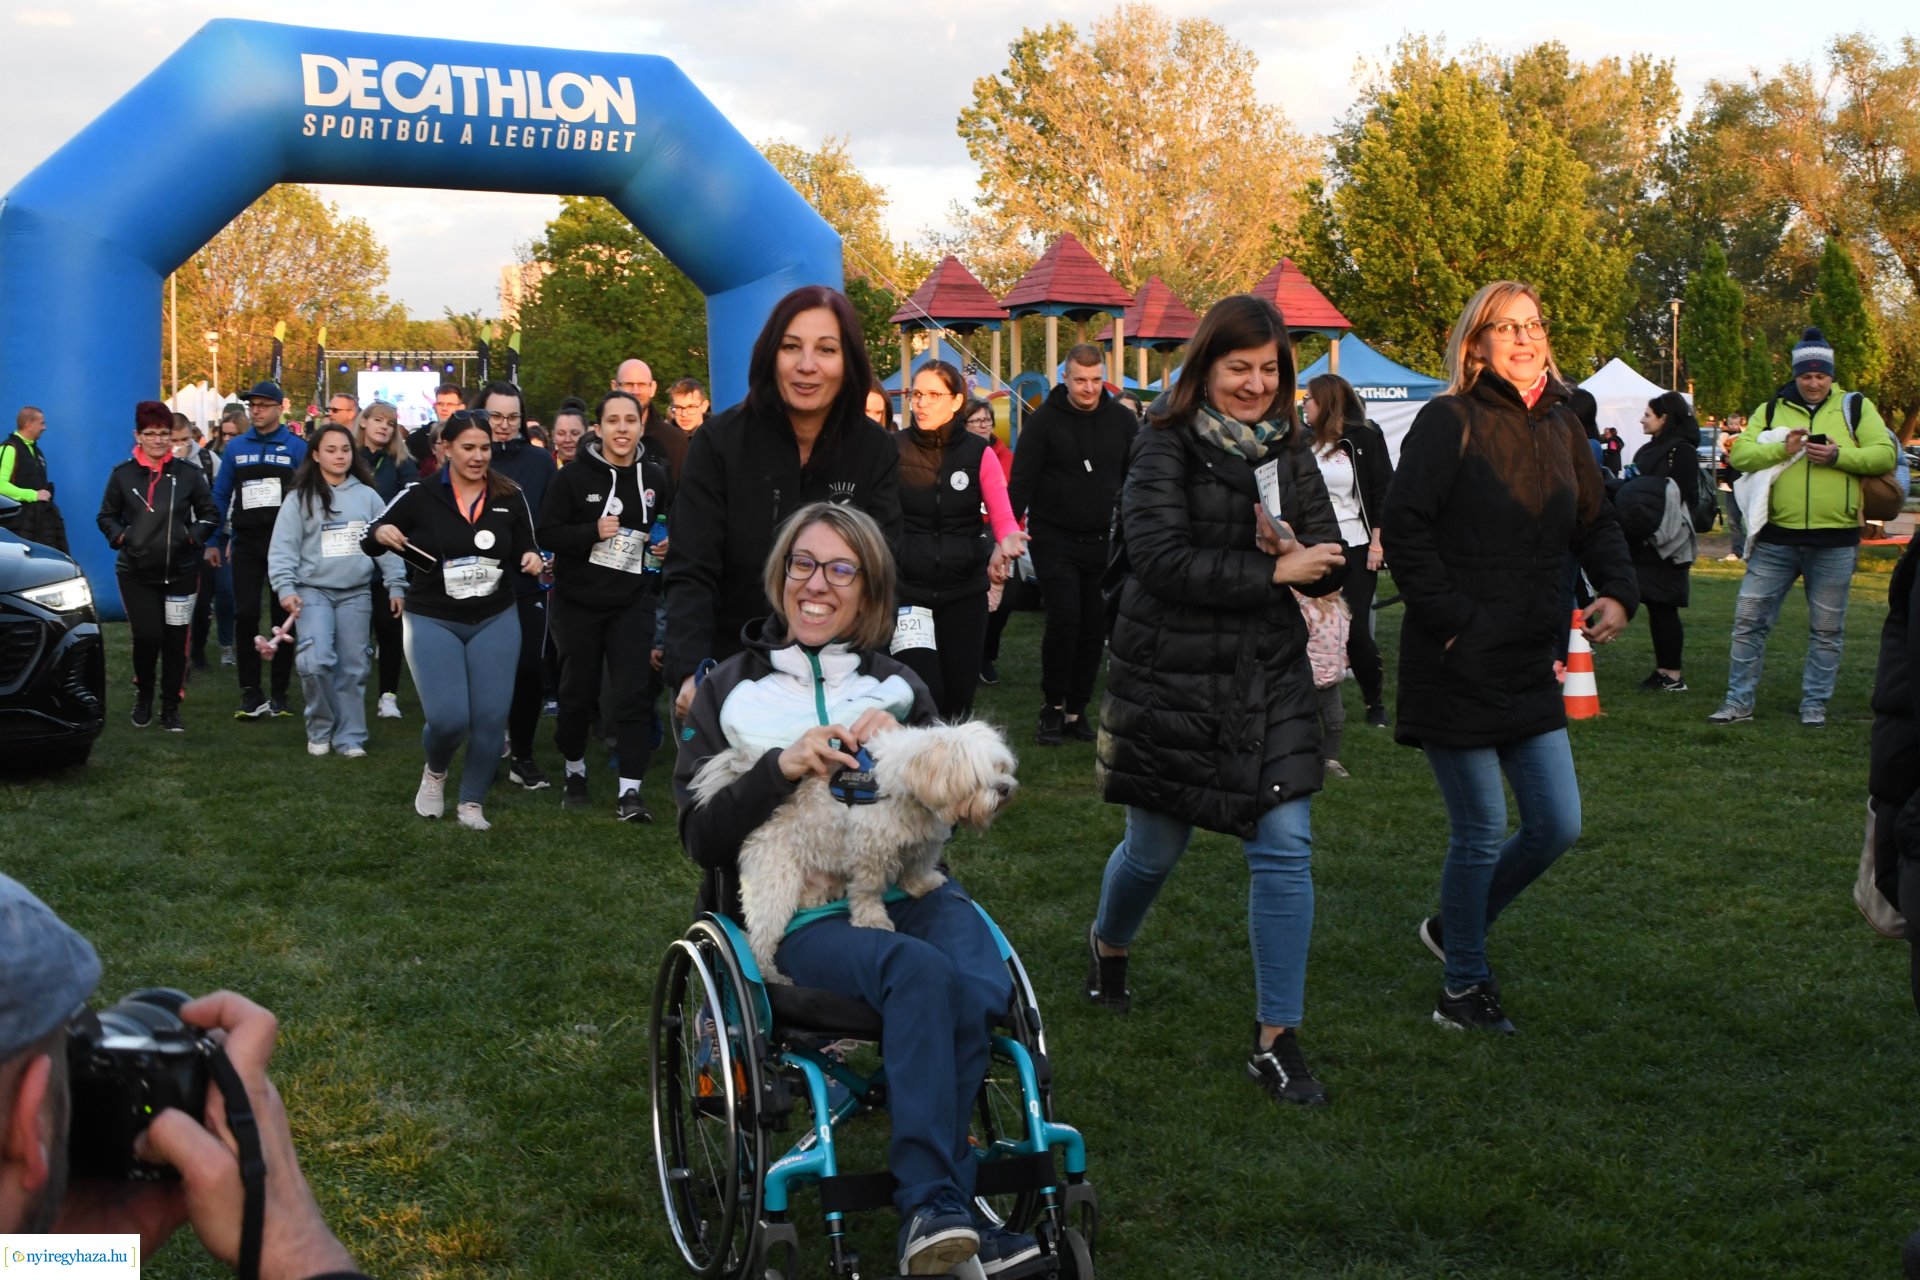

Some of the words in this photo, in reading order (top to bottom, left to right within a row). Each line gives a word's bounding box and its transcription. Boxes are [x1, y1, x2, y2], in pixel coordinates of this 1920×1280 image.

[300, 53, 637, 125] DECATHLON
[302, 113, 444, 145] SPORTBÓL
[460, 126, 474, 145] A
[489, 122, 637, 153] LEGTÖBBET
[250, 486, 271, 497] 1795
[609, 538, 637, 555] 1522
[462, 567, 489, 581] 1751
